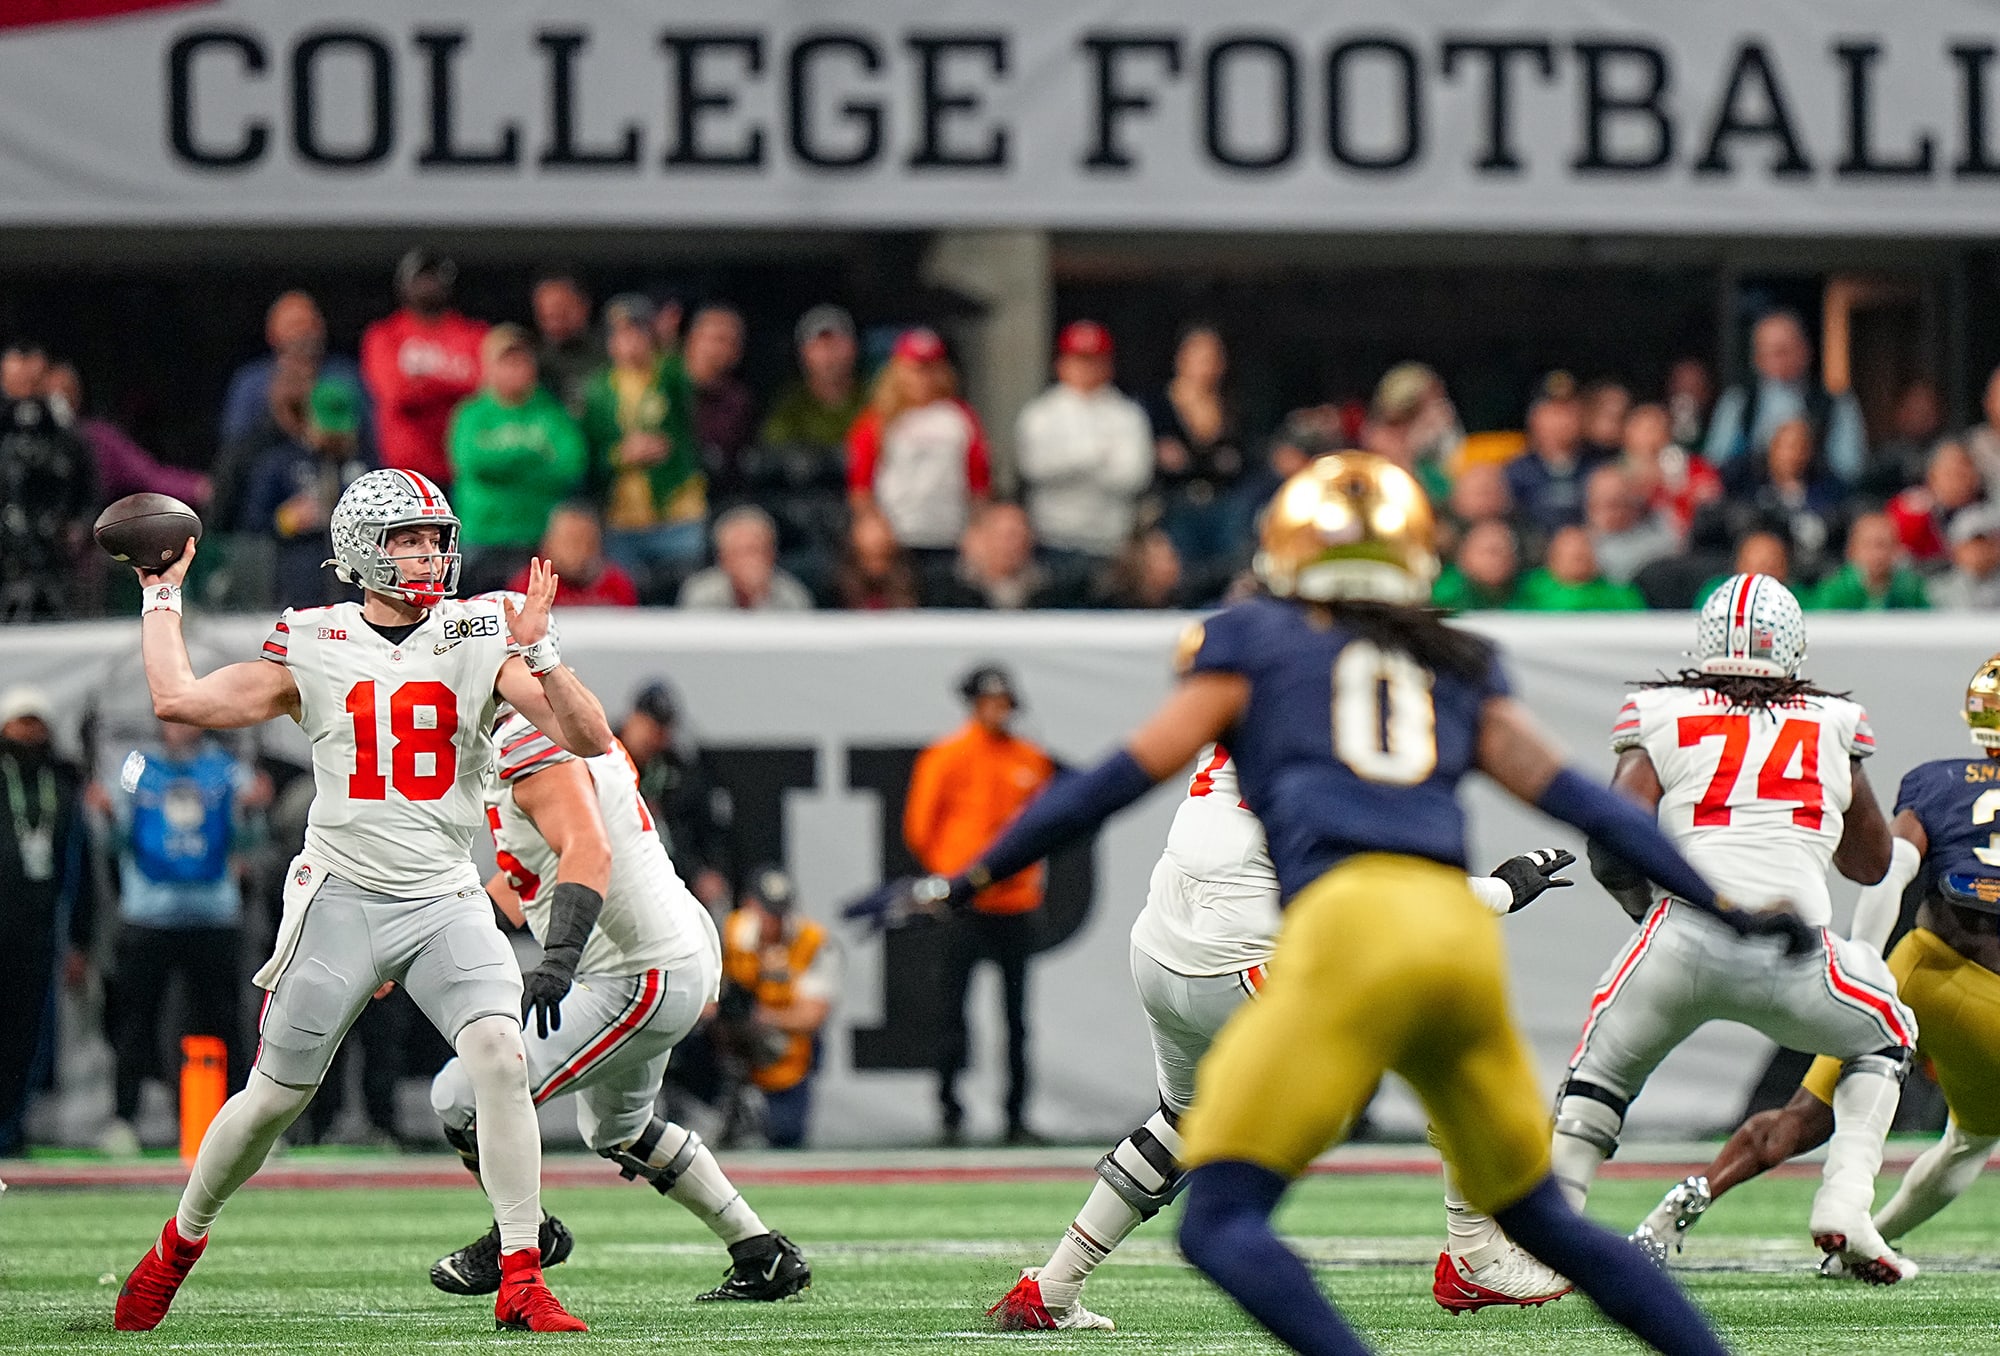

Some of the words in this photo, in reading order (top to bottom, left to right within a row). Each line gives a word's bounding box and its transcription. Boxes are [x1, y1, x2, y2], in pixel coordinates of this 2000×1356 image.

[167, 28, 1010, 172] COLLEGE
[443, 615, 500, 639] 2025
[345, 680, 458, 801] 18
[1331, 640, 1438, 787] 0
[1677, 715, 1824, 830] 74
